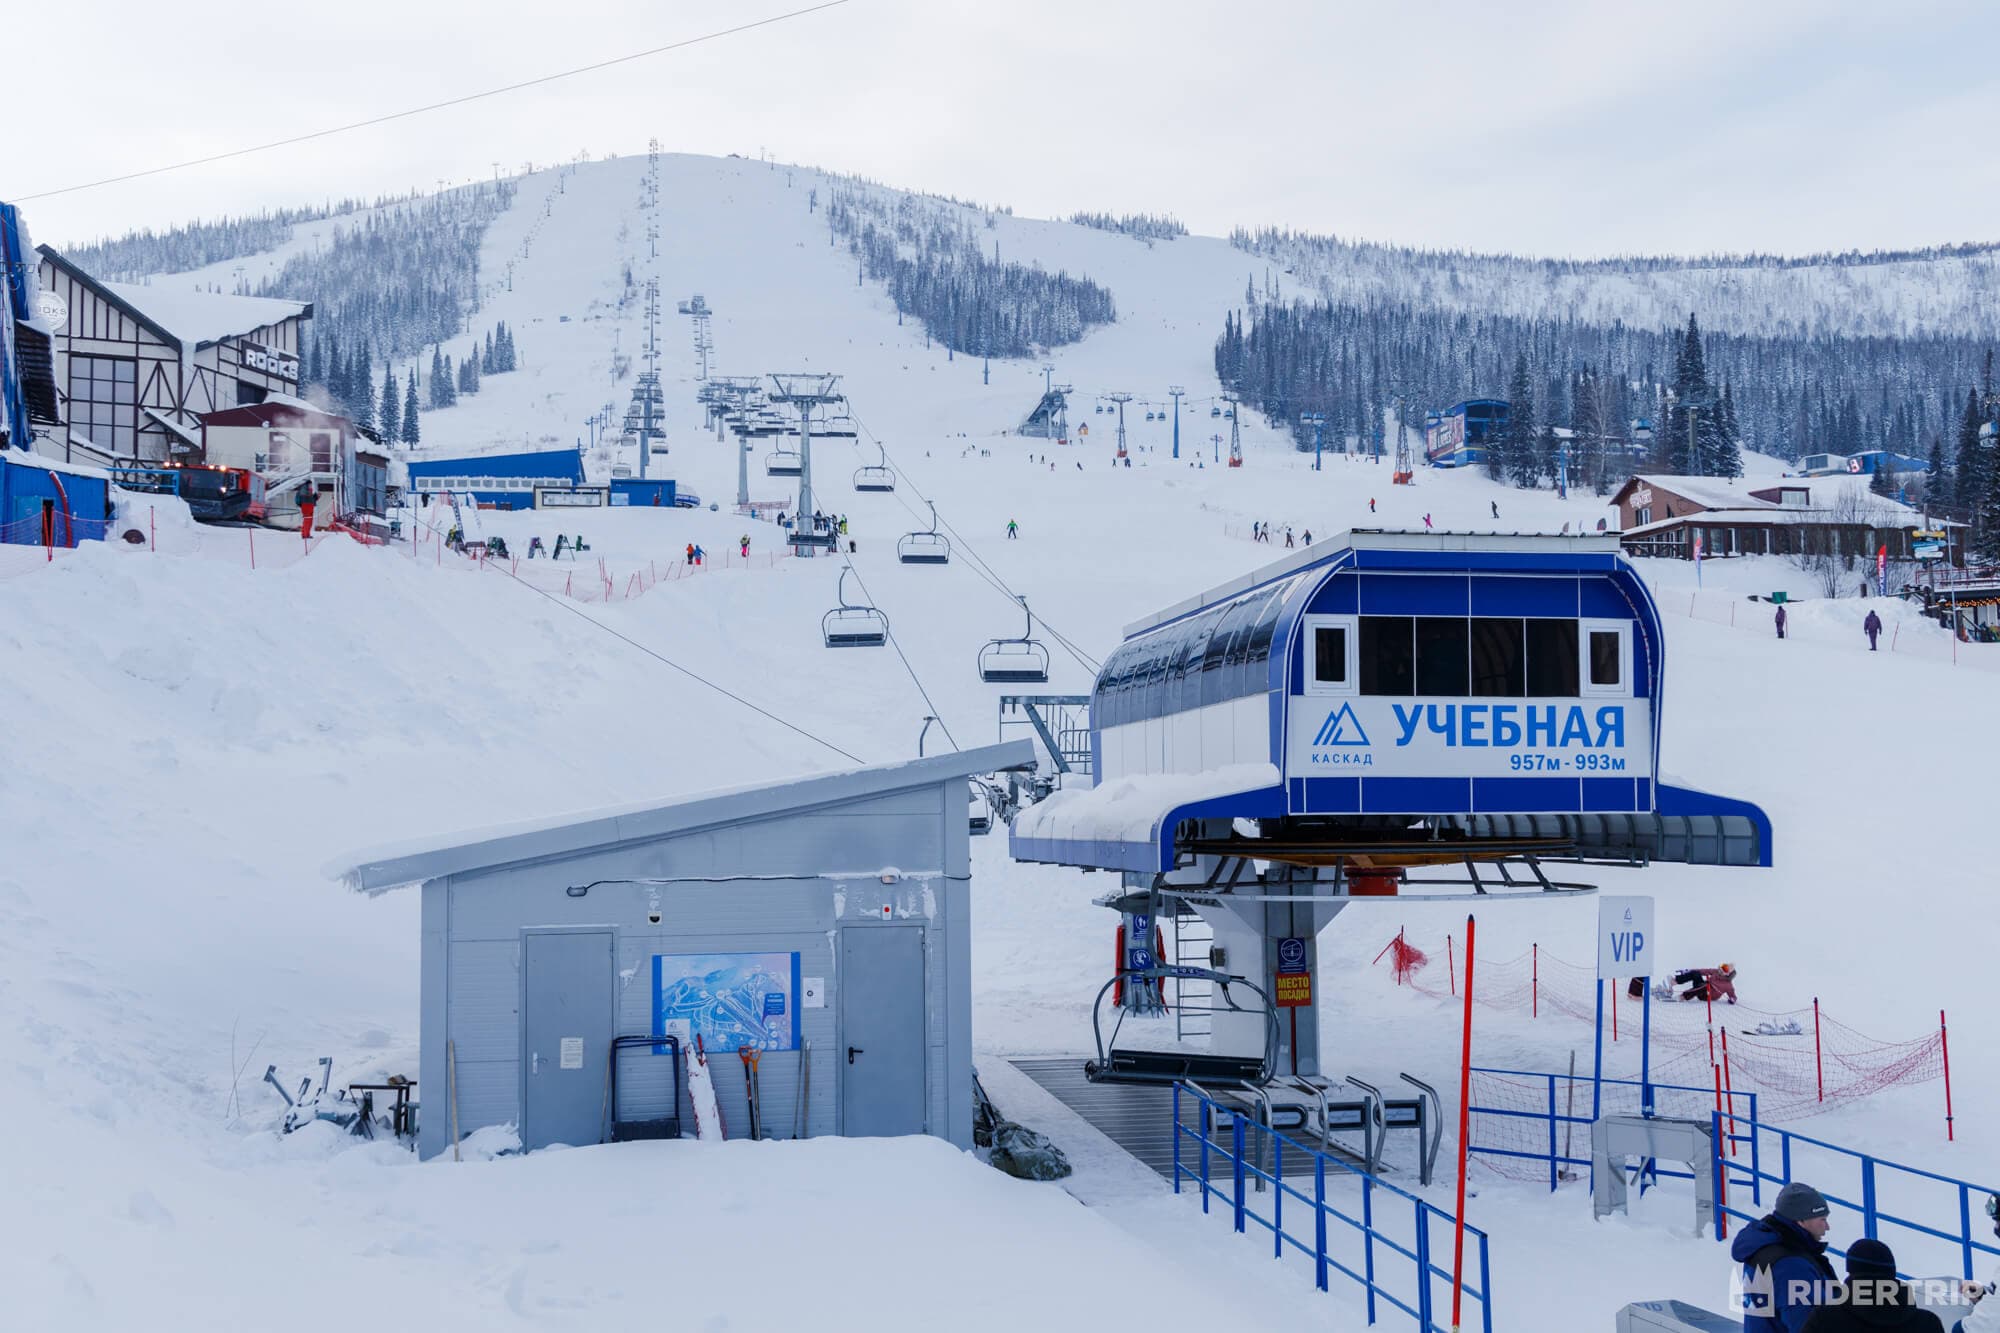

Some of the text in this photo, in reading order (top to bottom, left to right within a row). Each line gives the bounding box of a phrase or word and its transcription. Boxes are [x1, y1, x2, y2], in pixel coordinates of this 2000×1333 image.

[246, 349, 299, 380] ROOKS
[1393, 704, 1624, 748] УЧЕБНАЯ
[1312, 753, 1373, 766] КАСКАД
[1510, 754, 1560, 771] 957м
[1575, 754, 1625, 771] 993м
[1611, 932, 1644, 961] VIP
[1278, 977, 1309, 989] МЕСТО
[1279, 989, 1309, 1001] ПОСАДКИ
